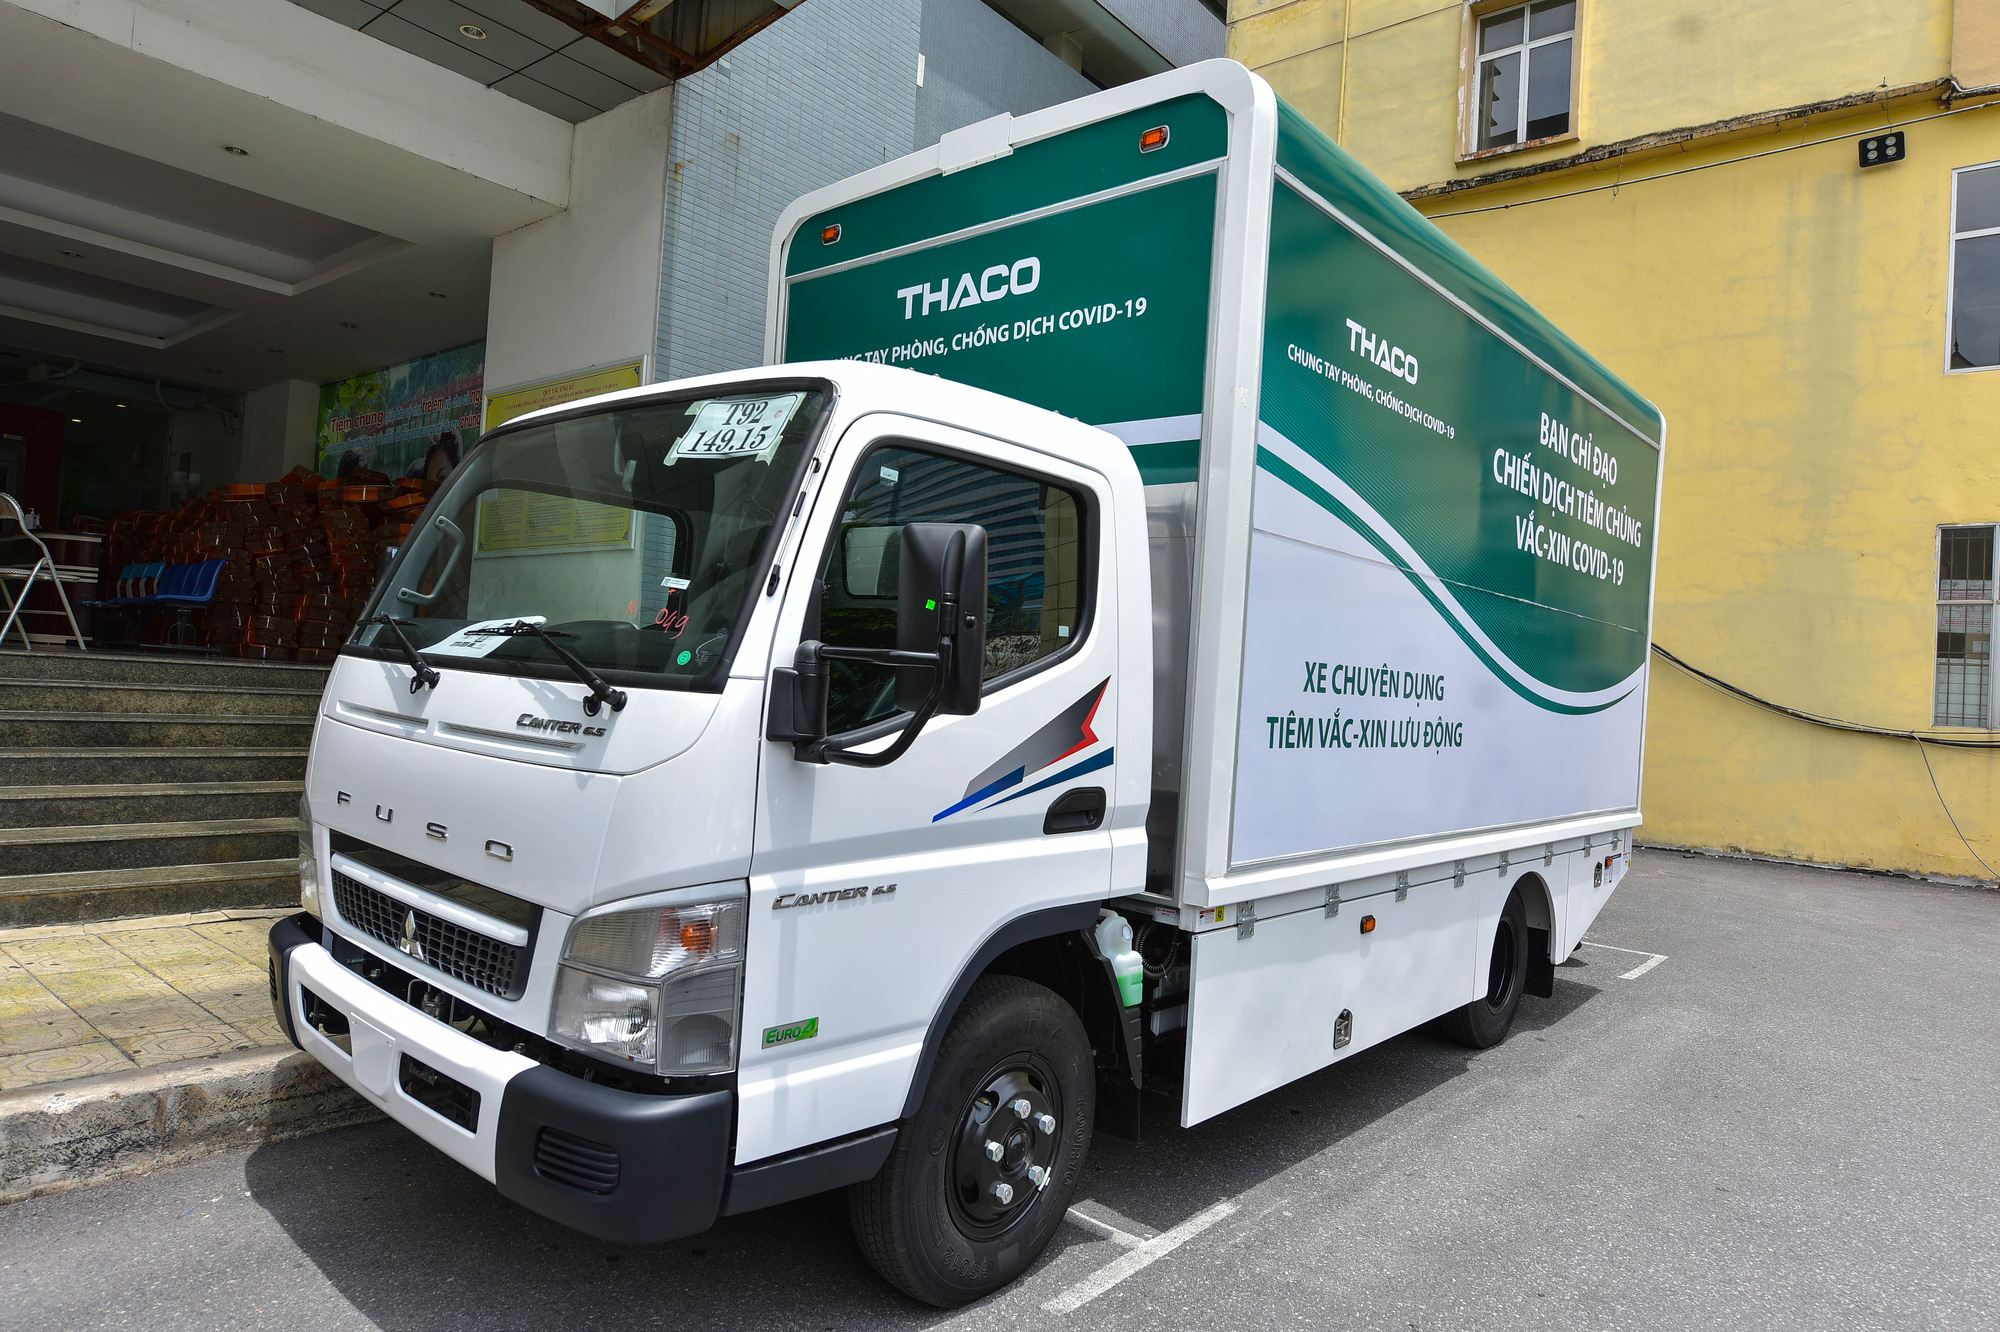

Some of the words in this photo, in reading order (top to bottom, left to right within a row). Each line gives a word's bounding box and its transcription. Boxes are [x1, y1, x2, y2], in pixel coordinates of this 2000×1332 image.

[897, 256, 1040, 320] THACO
[865, 348, 889, 365] TAY
[892, 338, 948, 363] PHÒNG,
[951, 323, 1009, 351] CHỐNG
[1013, 314, 1055, 343] DỊCH
[1058, 296, 1147, 331] COVID-19
[1346, 317, 1419, 385] THACO
[330, 416, 352, 433] Tiêm
[354, 408, 385, 428] chủng
[432, 397, 445, 412] em
[722, 401, 769, 425] T92
[1287, 343, 1323, 374] CHUNG
[1323, 361, 1341, 383] TAY
[1341, 370, 1375, 402] PHÒNG,
[1375, 390, 1404, 415] CHỐNG
[1404, 403, 1423, 424] DỊCH
[1423, 413, 1455, 440] COVID-19
[687, 425, 772, 453] 149.15
[1539, 411, 1569, 458] BAN
[1570, 432, 1593, 472] CHỈ
[1593, 445, 1618, 489] ĐẠO
[1493, 447, 1540, 500] CHIẾN
[1542, 471, 1575, 518] DỊCH
[1576, 489, 1604, 531] TIÊM
[1605, 504, 1642, 548] CHỦNG
[1515, 509, 1571, 568] VẮC-XIN
[1572, 540, 1624, 586] COVID-19
[656, 608, 690, 640] 049
[1303, 661, 1328, 694] XE
[1331, 662, 1400, 698] CHUYÊN
[1403, 671, 1445, 708] DỤNG
[1266, 709, 1314, 749] TIÊM
[1318, 707, 1387, 749] VẮC-XIN
[1390, 716, 1421, 748] LƯU
[1423, 715, 1463, 755] ĐỘNG
[337, 790, 515, 862] FUSO
[871, 883, 898, 896] 6.5
